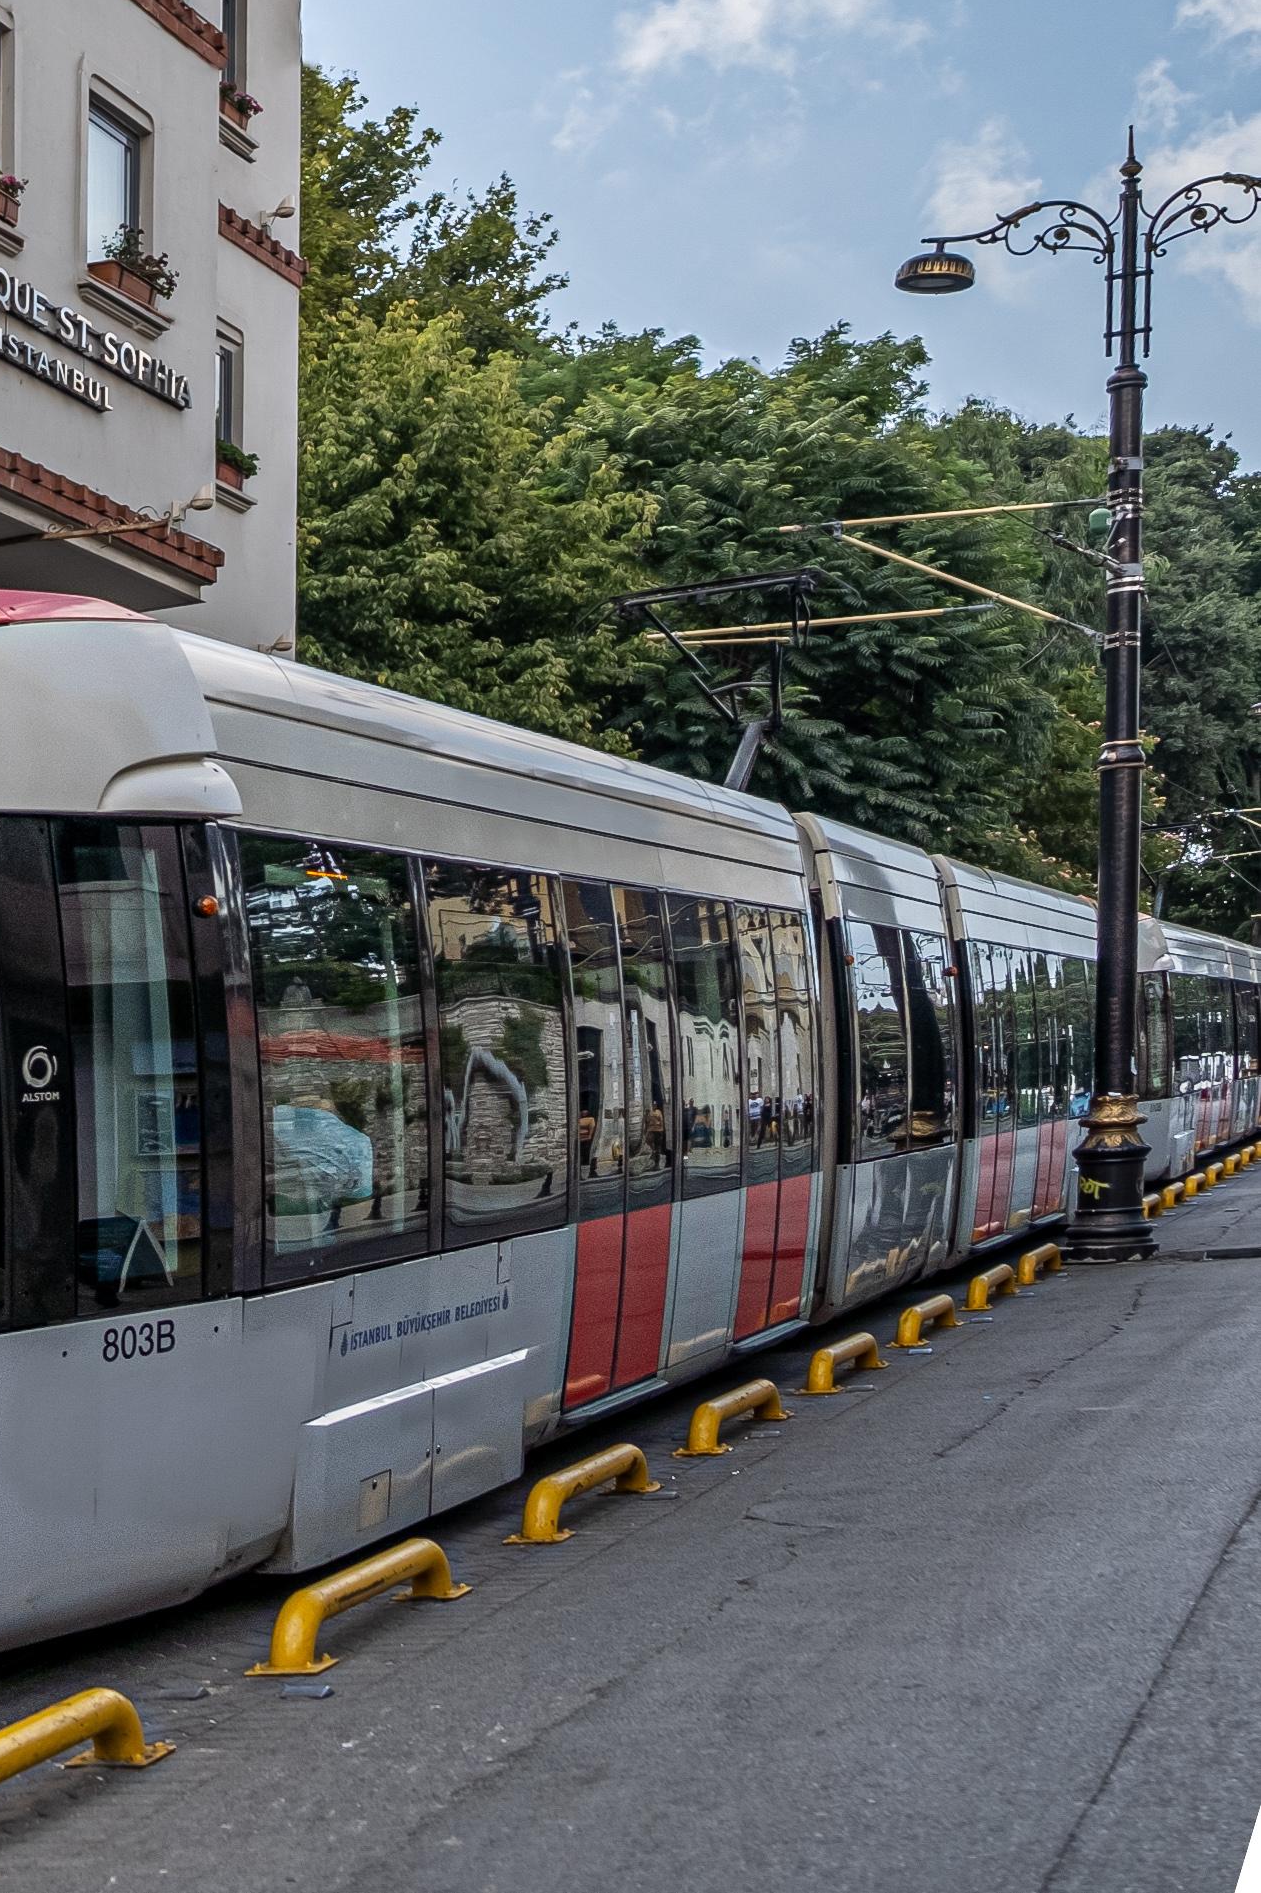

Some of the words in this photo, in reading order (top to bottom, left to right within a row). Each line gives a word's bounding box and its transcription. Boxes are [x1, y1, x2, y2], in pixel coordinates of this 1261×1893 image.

[58, 307, 94, 352] ST.
[21, 1091, 60, 1103] ALSTOM
[102, 1319, 176, 1363] 803B
[350, 1323, 393, 1351] İSTANBUL
[396, 1306, 451, 1338] BÜYÜKŞEHİR
[454, 1290, 501, 1322] BELEDİYESİ
